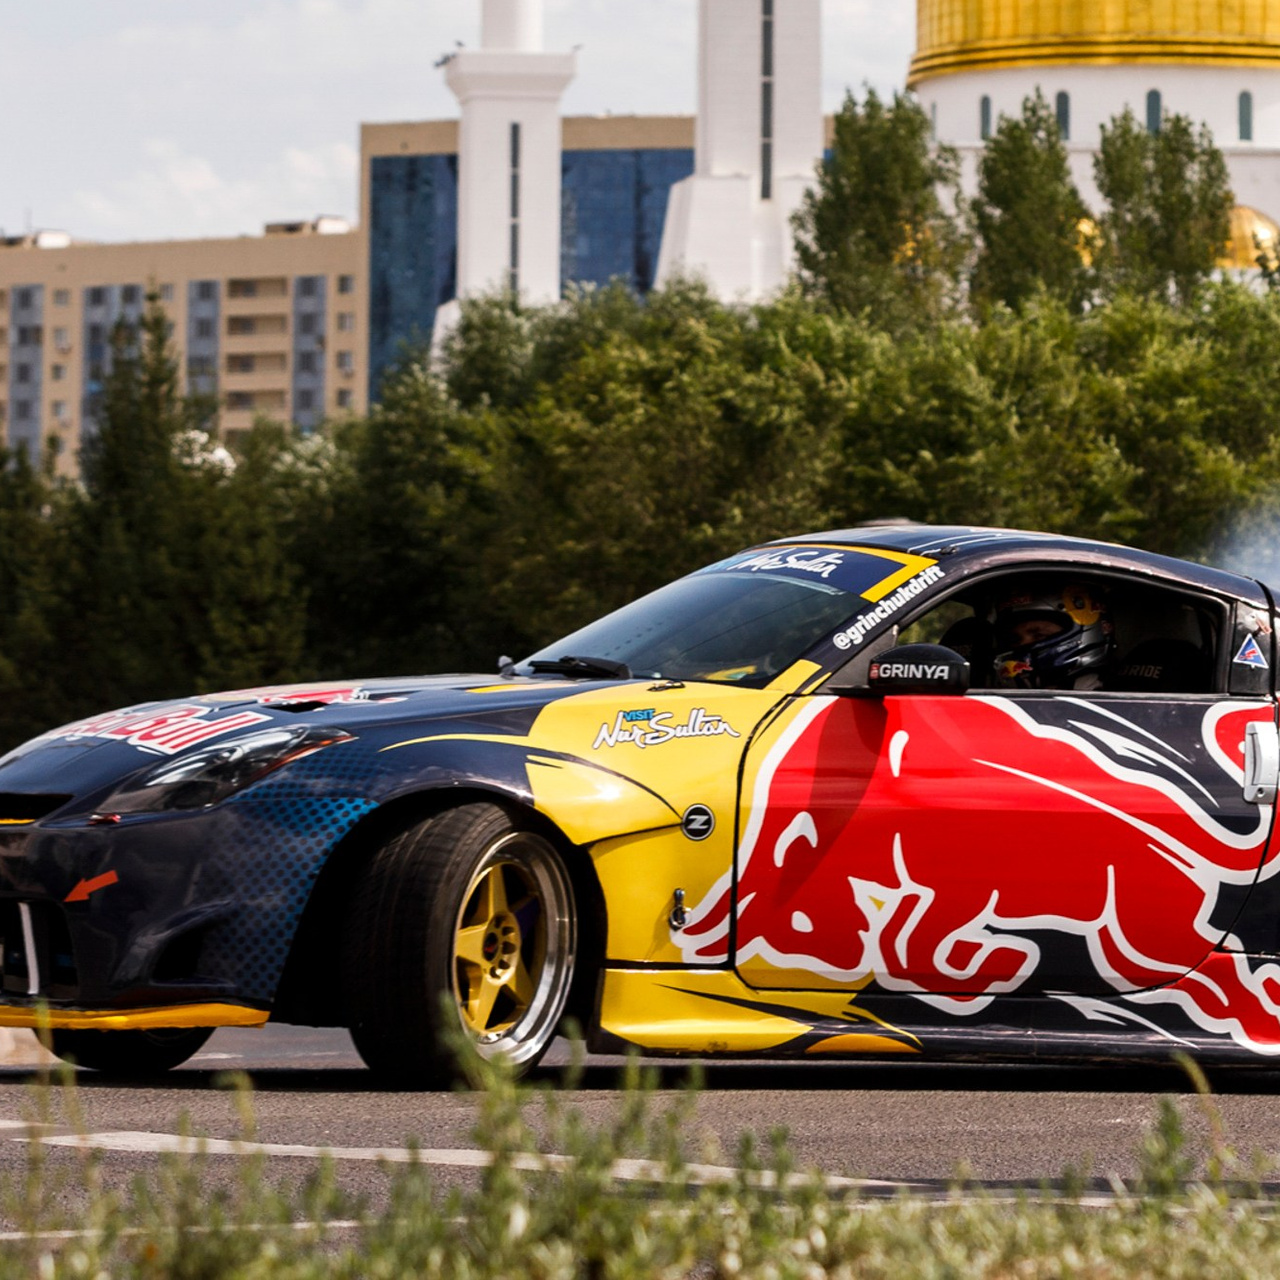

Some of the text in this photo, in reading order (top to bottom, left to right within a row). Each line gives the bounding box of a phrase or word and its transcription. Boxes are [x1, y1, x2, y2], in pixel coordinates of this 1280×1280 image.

[832, 565, 946, 650] @grinchukdrift
[879, 663, 949, 680] GRINYA
[592, 708, 741, 750] Nur Sultan
[623, 708, 655, 722] VISIT
